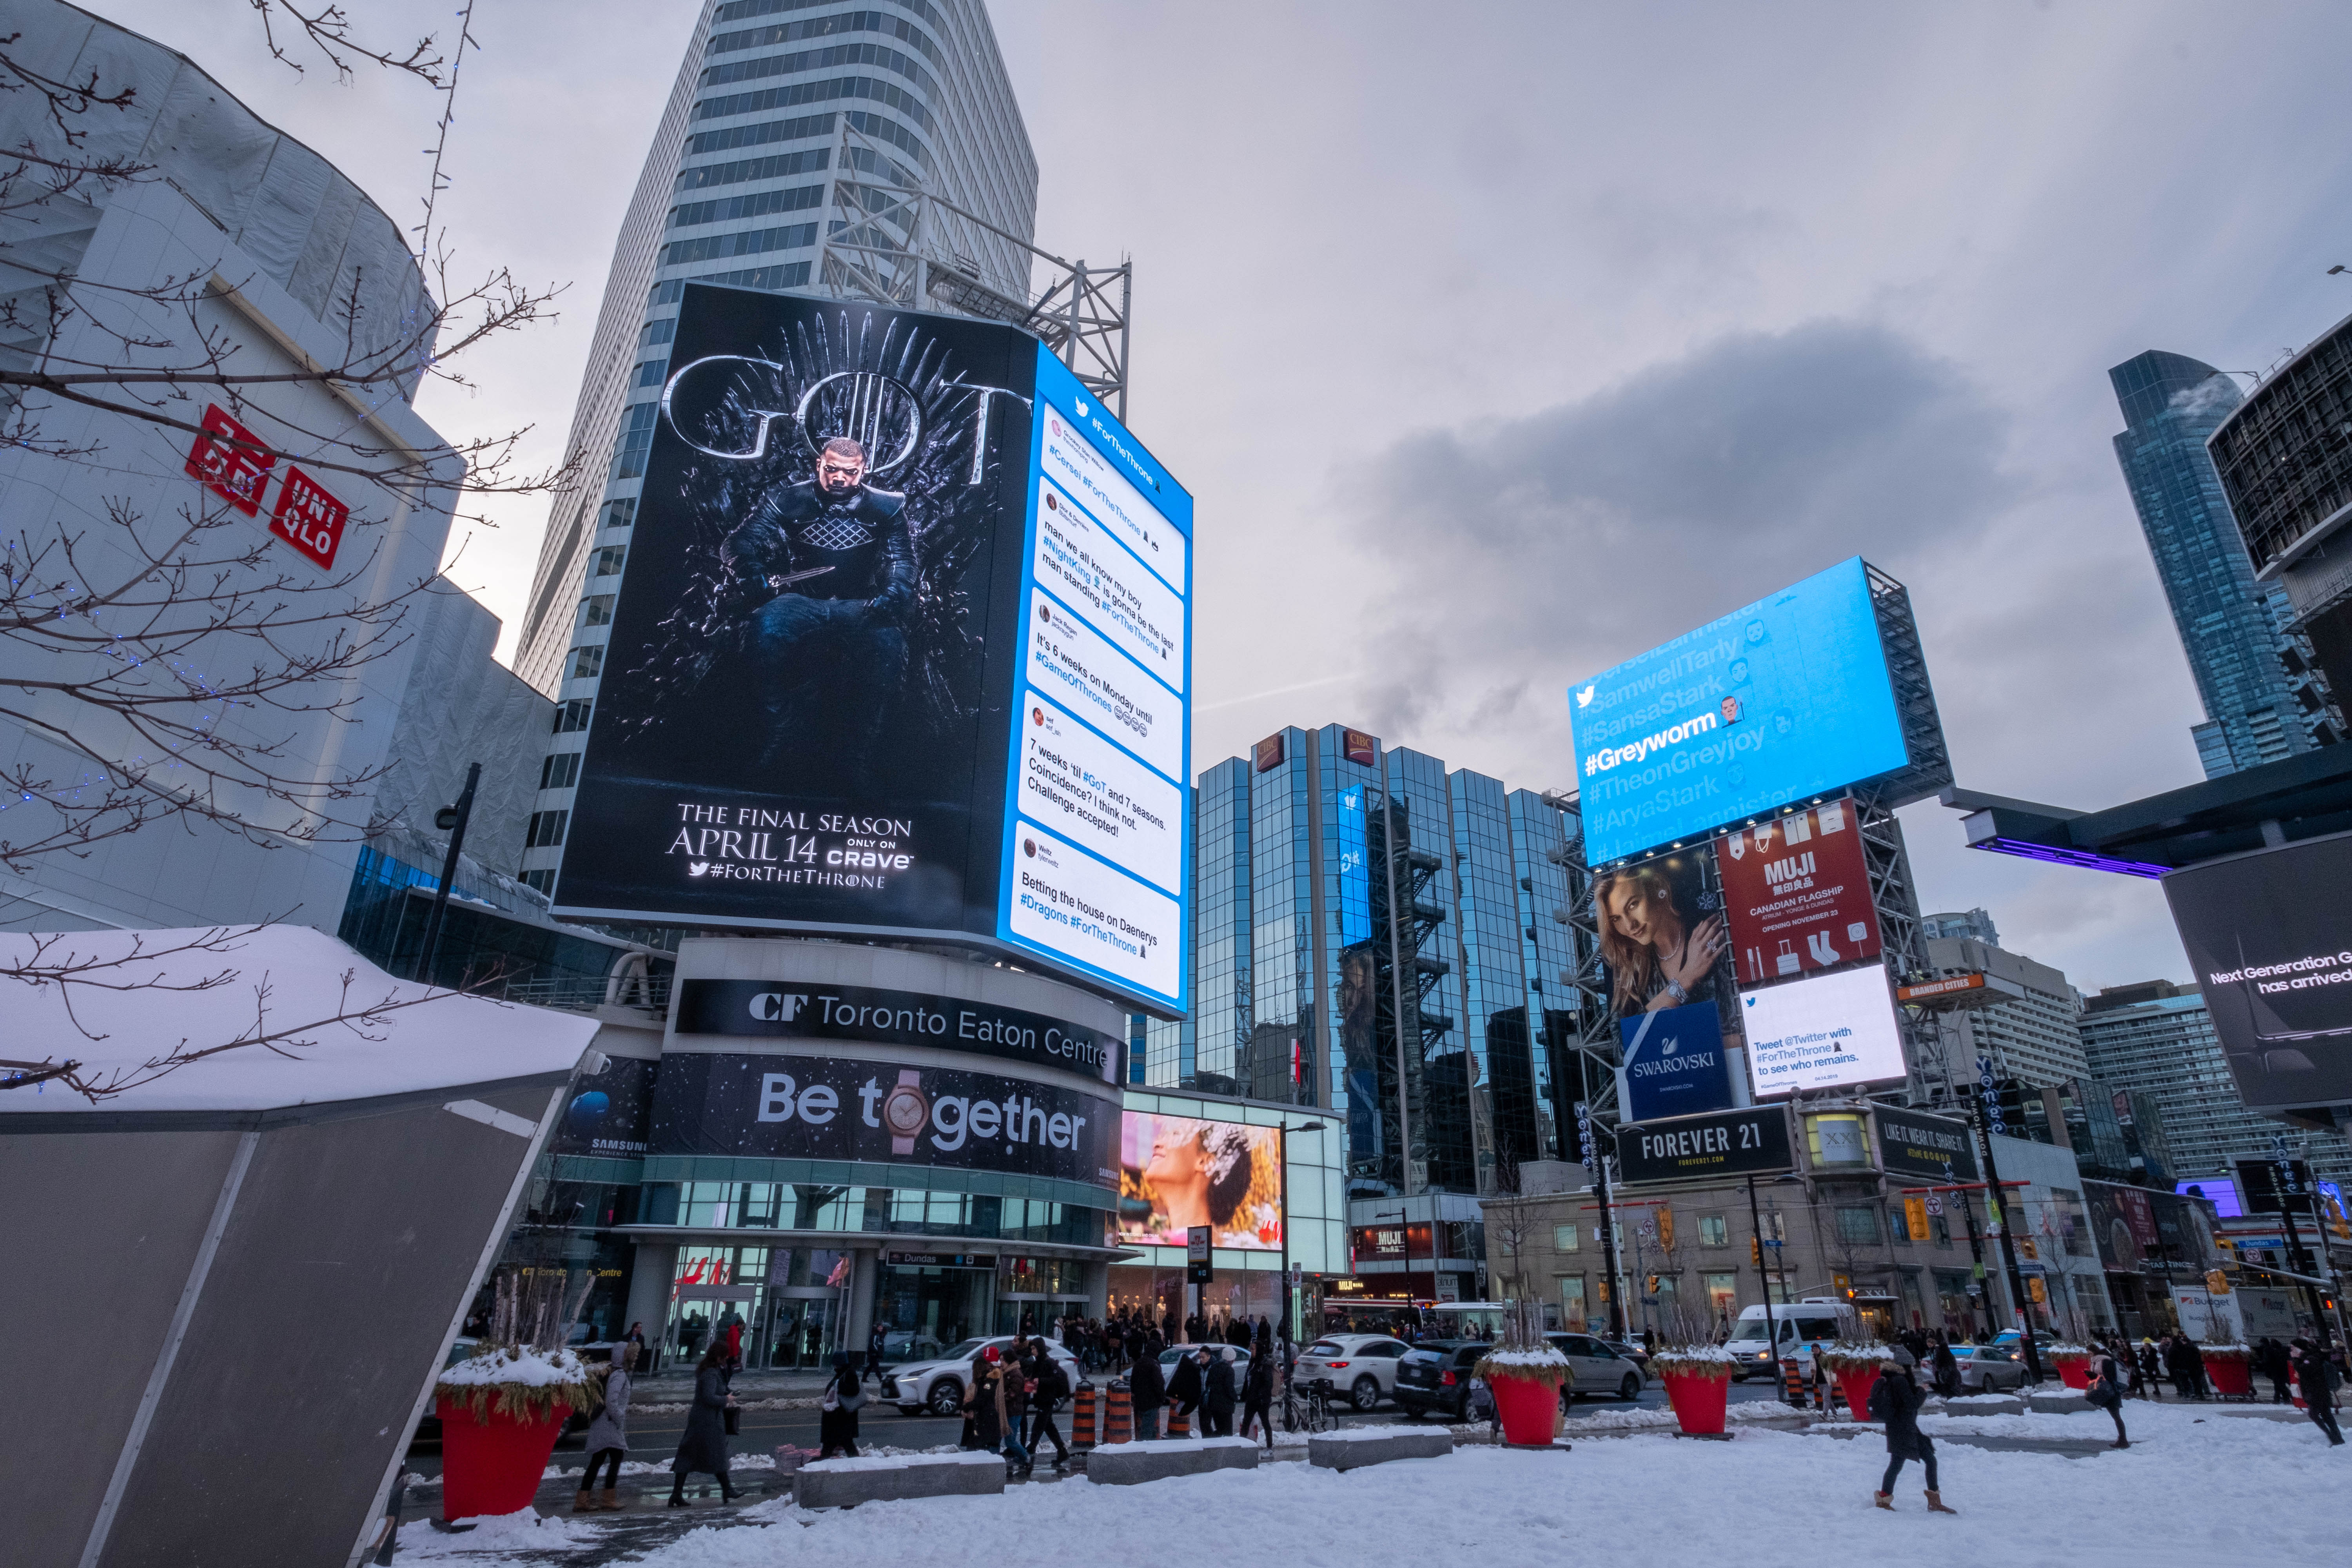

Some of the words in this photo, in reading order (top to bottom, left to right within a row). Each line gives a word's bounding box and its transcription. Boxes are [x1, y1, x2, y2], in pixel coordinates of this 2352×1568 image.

[661, 355, 1033, 485] GOT
[1092, 417, 1153, 485] #ForTheThrone
[292, 480, 336, 528] UNI
[1049, 445, 1081, 480] #Cersei
[1082, 475, 1140, 535] #ForTheThrone
[283, 508, 331, 554] QLO
[1044, 521, 1063, 543] man
[1065, 538, 1078, 554] we
[1079, 551, 1089, 564] all
[1091, 558, 1112, 584] know
[1114, 580, 1126, 597] my
[1127, 589, 1142, 610] boy
[1042, 553, 1062, 575] man
[1063, 570, 1100, 608] standing
[1101, 600, 1159, 653] #ForTheThrone
[1043, 535, 1091, 584] #NightKing
[1103, 584, 1110, 598] is
[1112, 594, 1136, 620] gonna
[1137, 613, 1147, 628] be
[1148, 623, 1160, 639] the
[1161, 633, 1174, 652] last
[1052, 613, 1063, 624] Jack
[1035, 650, 1112, 712] #GameOfThrones
[1052, 644, 1058, 657] 6
[1060, 652, 1087, 678] weeks
[1089, 674, 1100, 688] on
[1102, 680, 1134, 713] Monday
[1136, 707, 1152, 725] until
[1583, 674, 1725, 746] #SansaStark
[1258, 737, 1277, 754] CIBC
[1350, 732, 1372, 748] CIBC
[1585, 711, 1717, 777] #Greyworm
[1589, 724, 1765, 805] #TheonGreyjoy
[1029, 757, 1092, 803] Coincidence?
[1094, 795, 1097, 807] I
[1098, 799, 1120, 820] think
[1122, 814, 1136, 830] not.
[1030, 737, 1036, 750] 7
[1038, 745, 1067, 771] weeks
[1083, 771, 1106, 793] #GoT
[1108, 788, 1123, 805] and
[1125, 796, 1131, 808] 7
[1132, 803, 1165, 831] seasons.
[678, 804, 728, 823] THE
[739, 808, 810, 830] FINAL
[818, 814, 912, 837] SEASON
[1027, 776, 1075, 813] Challenge
[1077, 807, 1118, 838] accepted!
[1593, 775, 1721, 835] #AryaStark
[665, 826, 778, 861] APRIL
[784, 835, 818, 864] 14
[847, 838, 876, 848] ONLY
[880, 841, 896, 849] ON
[1764, 851, 1817, 886] MUJI
[1773, 877, 1814, 896] 無印良品
[1022, 871, 1057, 903] Betting
[1059, 890, 1074, 907] the
[1077, 897, 1104, 921] house
[1106, 915, 1118, 927] on
[1120, 918, 1157, 946] Daenerys
[1750, 898, 1797, 916] CANADIAN
[1798, 886, 1844, 903] FLAGSHIP
[1762, 913, 1782, 921] ATRIUM
[1786, 905, 1805, 915] YONGE
[1811, 898, 1835, 910] DUNDAS
[1020, 893, 1068, 925] #Dragons
[1070, 915, 1137, 955] #ForTheThrone
[1762, 922, 1791, 933] OPENING
[1792, 912, 1829, 926] NOVEMBER
[1909, 982, 1944, 997] BRANDED
[1945, 978, 1970, 991] CITIES
[2210, 969, 2244, 985] Next
[2244, 954, 2337, 979] Generation
[2258, 980, 2290, 994] has
[749, 992, 809, 1022] CF
[818, 995, 947, 1035] Toronto
[958, 1011, 1036, 1050] Eaton
[1044, 1028, 1109, 1069] Centre
[1754, 1038, 1784, 1052] Tweet
[1784, 1032, 1827, 1047] @Twitter
[1829, 1027, 1853, 1039] with
[1633, 1051, 1715, 1078] SWAROVSKI
[1756, 1044, 1831, 1063] #ForTheThrone
[1758, 1066, 1768, 1076] to
[1770, 1064, 1788, 1074] see
[1790, 1059, 1812, 1071] who
[1814, 1053, 1859, 1068] remains.
[758, 1072, 839, 1124] Be
[858, 1076, 1086, 1151] tgether
[1971, 1100, 1988, 1156] DOWNTOWN
[1641, 1127, 1731, 1159] FOREVER
[1739, 1123, 1761, 1149] 21
[1884, 1122, 1901, 1141] LIKE
[1908, 1127, 1929, 1146] WEAR
[1935, 1132, 1958, 1151] SHARE
[1678, 1155, 1724, 1167] FOREVER21.COM
[1378, 1230, 1401, 1246] MUJI
[904, 1254, 936, 1263] Dundas
[1338, 1280, 1353, 1291] MUJI
